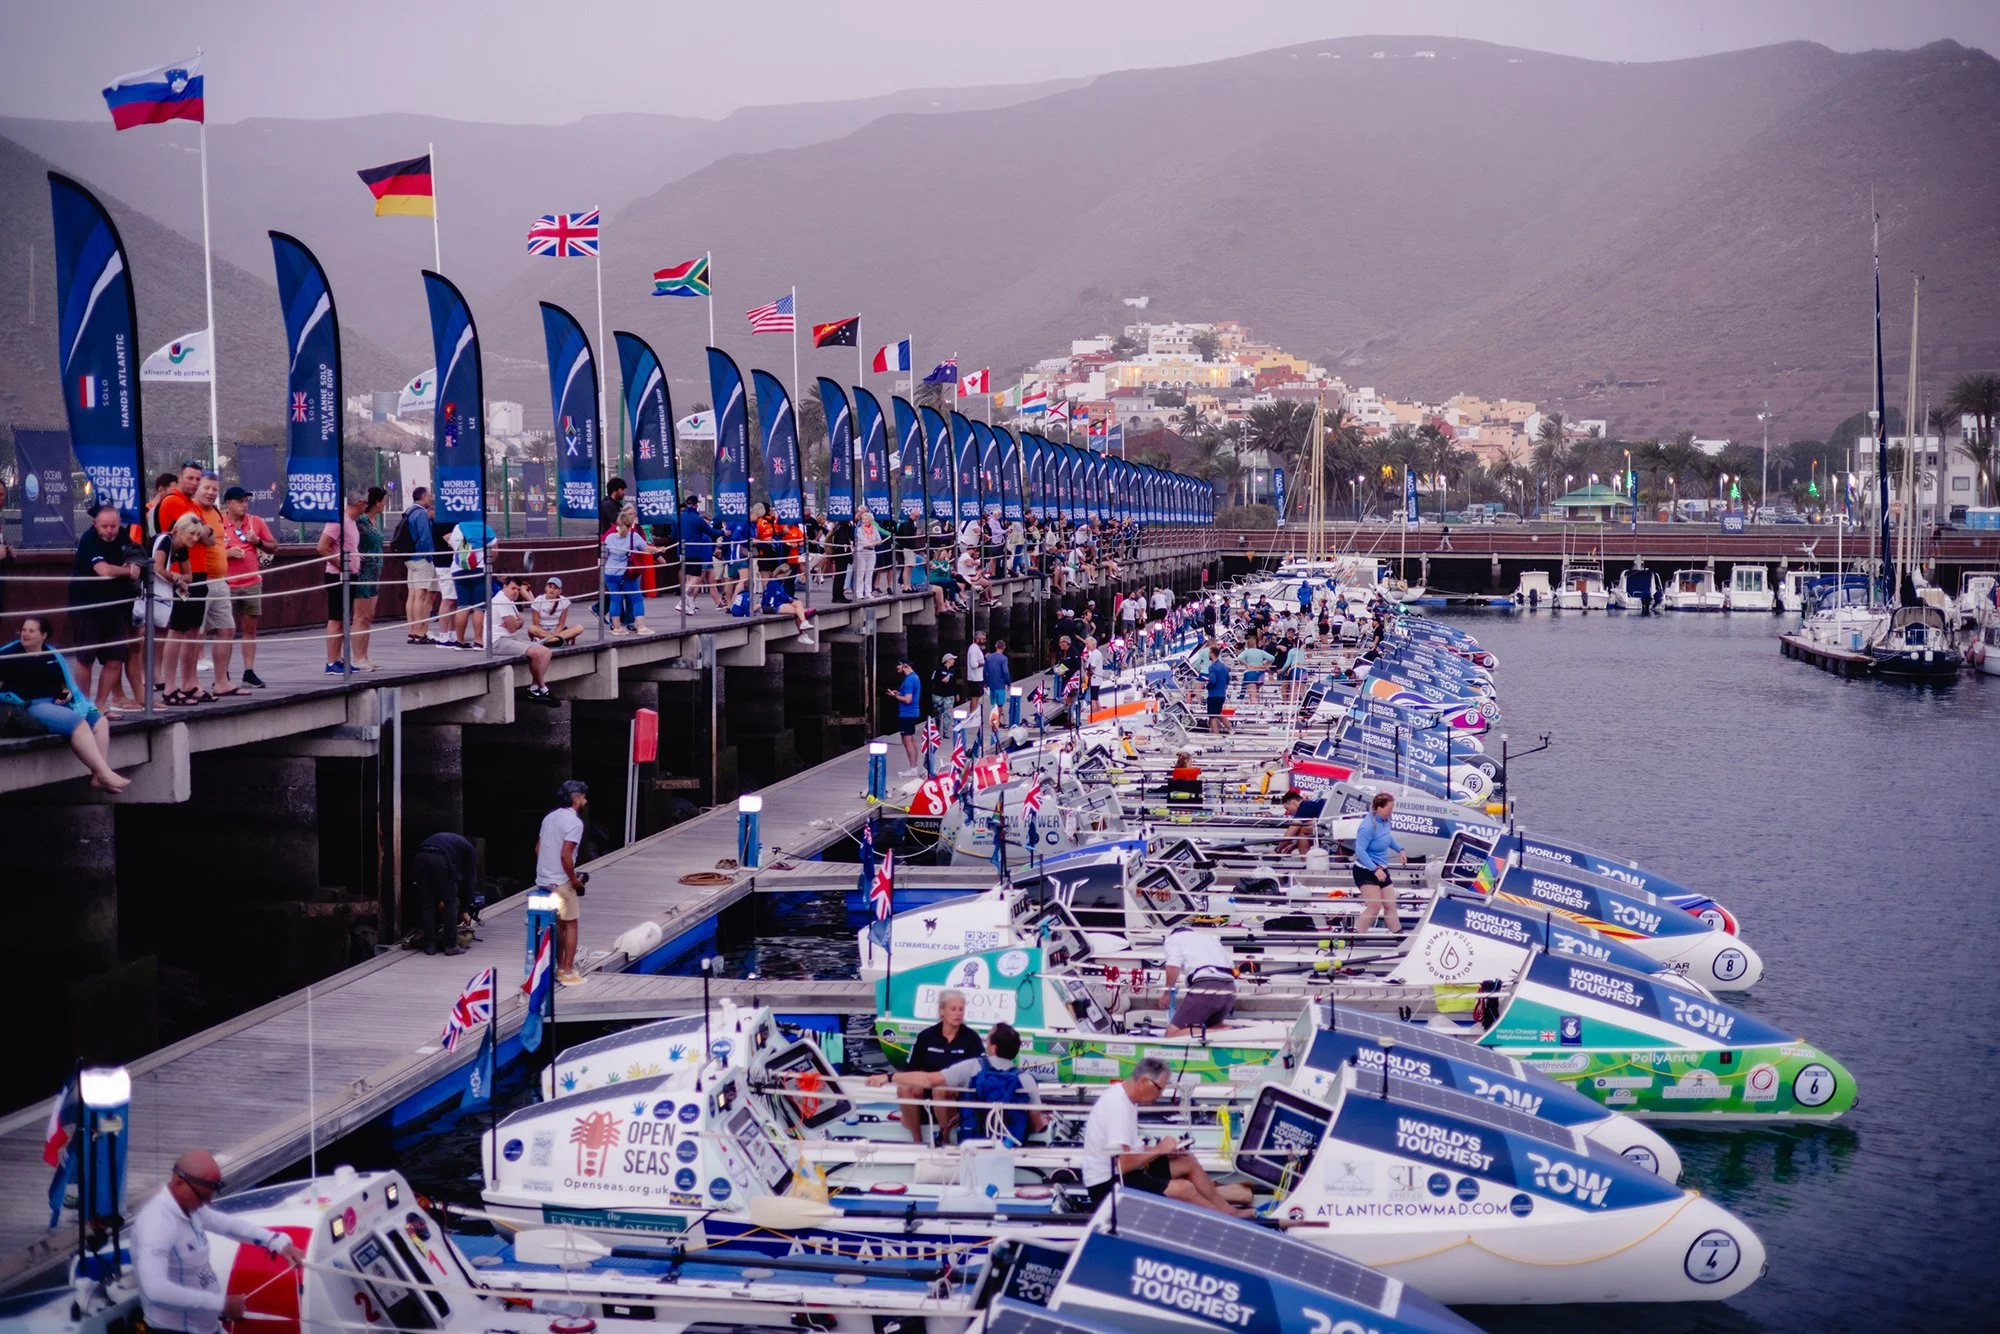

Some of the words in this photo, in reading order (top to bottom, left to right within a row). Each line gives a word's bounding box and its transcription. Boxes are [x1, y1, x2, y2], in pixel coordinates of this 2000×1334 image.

[115, 333, 129, 387] ATLANTIC
[319, 363, 327, 386] SOLO
[326, 368, 334, 389] ROW
[119, 390, 130, 428] HANDS
[320, 388, 328, 412] ANNE
[327, 391, 335, 433] ATLANTIC
[658, 405, 669, 454] ENTREPRENEUR
[288, 474, 333, 483] WORLD'S
[443, 480, 476, 488] WORLD'S
[288, 492, 336, 510] ROW
[440, 487, 479, 496] TOUGHEST
[440, 496, 480, 512] ROW
[638, 504, 675, 516] ROW
[1423, 685, 1445, 700] ROW
[1440, 679, 1461, 693] ROW
[1362, 732, 1392, 744] WORLD'S
[1362, 737, 1396, 750] TOUGHEST
[1407, 744, 1437, 765] ROW
[1294, 774, 1330, 785] WORLD'S
[1469, 780, 1477, 789] 15
[1396, 802, 1424, 813] FREEDOM
[1426, 805, 1448, 814] ROWER
[914, 821, 939, 829] GREEN
[1391, 813, 1434, 825] WORLD'S
[1391, 820, 1440, 834] TOUGHEST
[1525, 845, 1572, 864] WORLD'S
[1531, 887, 1591, 911] TOUGHEST
[1533, 878, 1584, 900] WORLD'S
[1465, 909, 1522, 931] WORLD'S
[1609, 900, 1662, 934] ROW
[1465, 918, 1531, 945] TOUGHEST
[894, 940, 960, 951] LIZWARDLEY.COM
[1726, 959, 1734, 972] 8
[1569, 967, 1634, 995] WORLD'S
[1568, 978, 1644, 1008] TOUGHEST
[1668, 996, 1735, 1040] ROW
[1358, 1047, 1431, 1074] WORLD'S
[1631, 1051, 1698, 1064] PollyAnne
[1809, 1078, 1819, 1095] 6
[627, 1120, 677, 1147] OPEN
[1399, 1118, 1482, 1151] WORLD'S
[1397, 1132, 1494, 1171] TOUGHEST
[623, 1149, 671, 1176] SEAS
[564, 1177, 670, 1196] Openseas.org.uk
[1527, 1152, 1612, 1205] ROW
[607, 1211, 622, 1221] the
[1317, 1203, 1508, 1217] ATLANTICROWMAD.COM
[1705, 1249, 1718, 1270] 4
[1134, 1257, 1240, 1299] WORLD'S
[354, 1291, 381, 1323] 2
[1131, 1275, 1256, 1328] TOUGHEST
